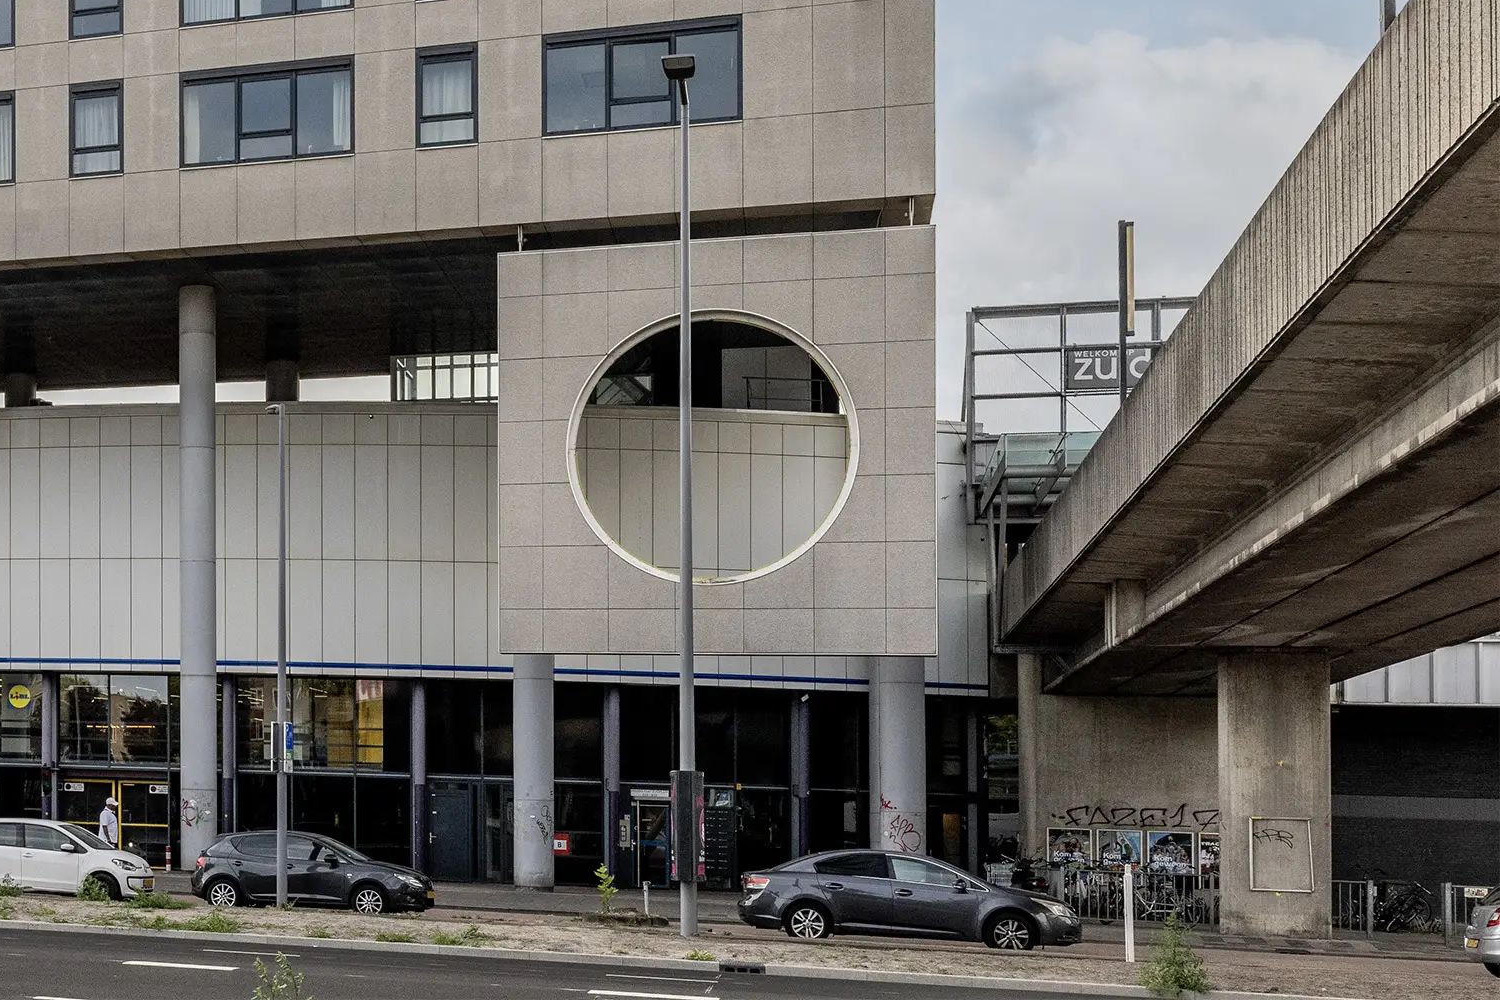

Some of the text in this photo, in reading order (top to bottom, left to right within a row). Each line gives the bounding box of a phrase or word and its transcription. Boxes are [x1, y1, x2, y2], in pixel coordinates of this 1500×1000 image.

[1074, 349, 1117, 357] WELKOM
[1074, 348, 1152, 380] zud
[1053, 850, 1072, 858] Kom
[1103, 852, 1121, 860] Kom
[1154, 854, 1173, 862] Kom
